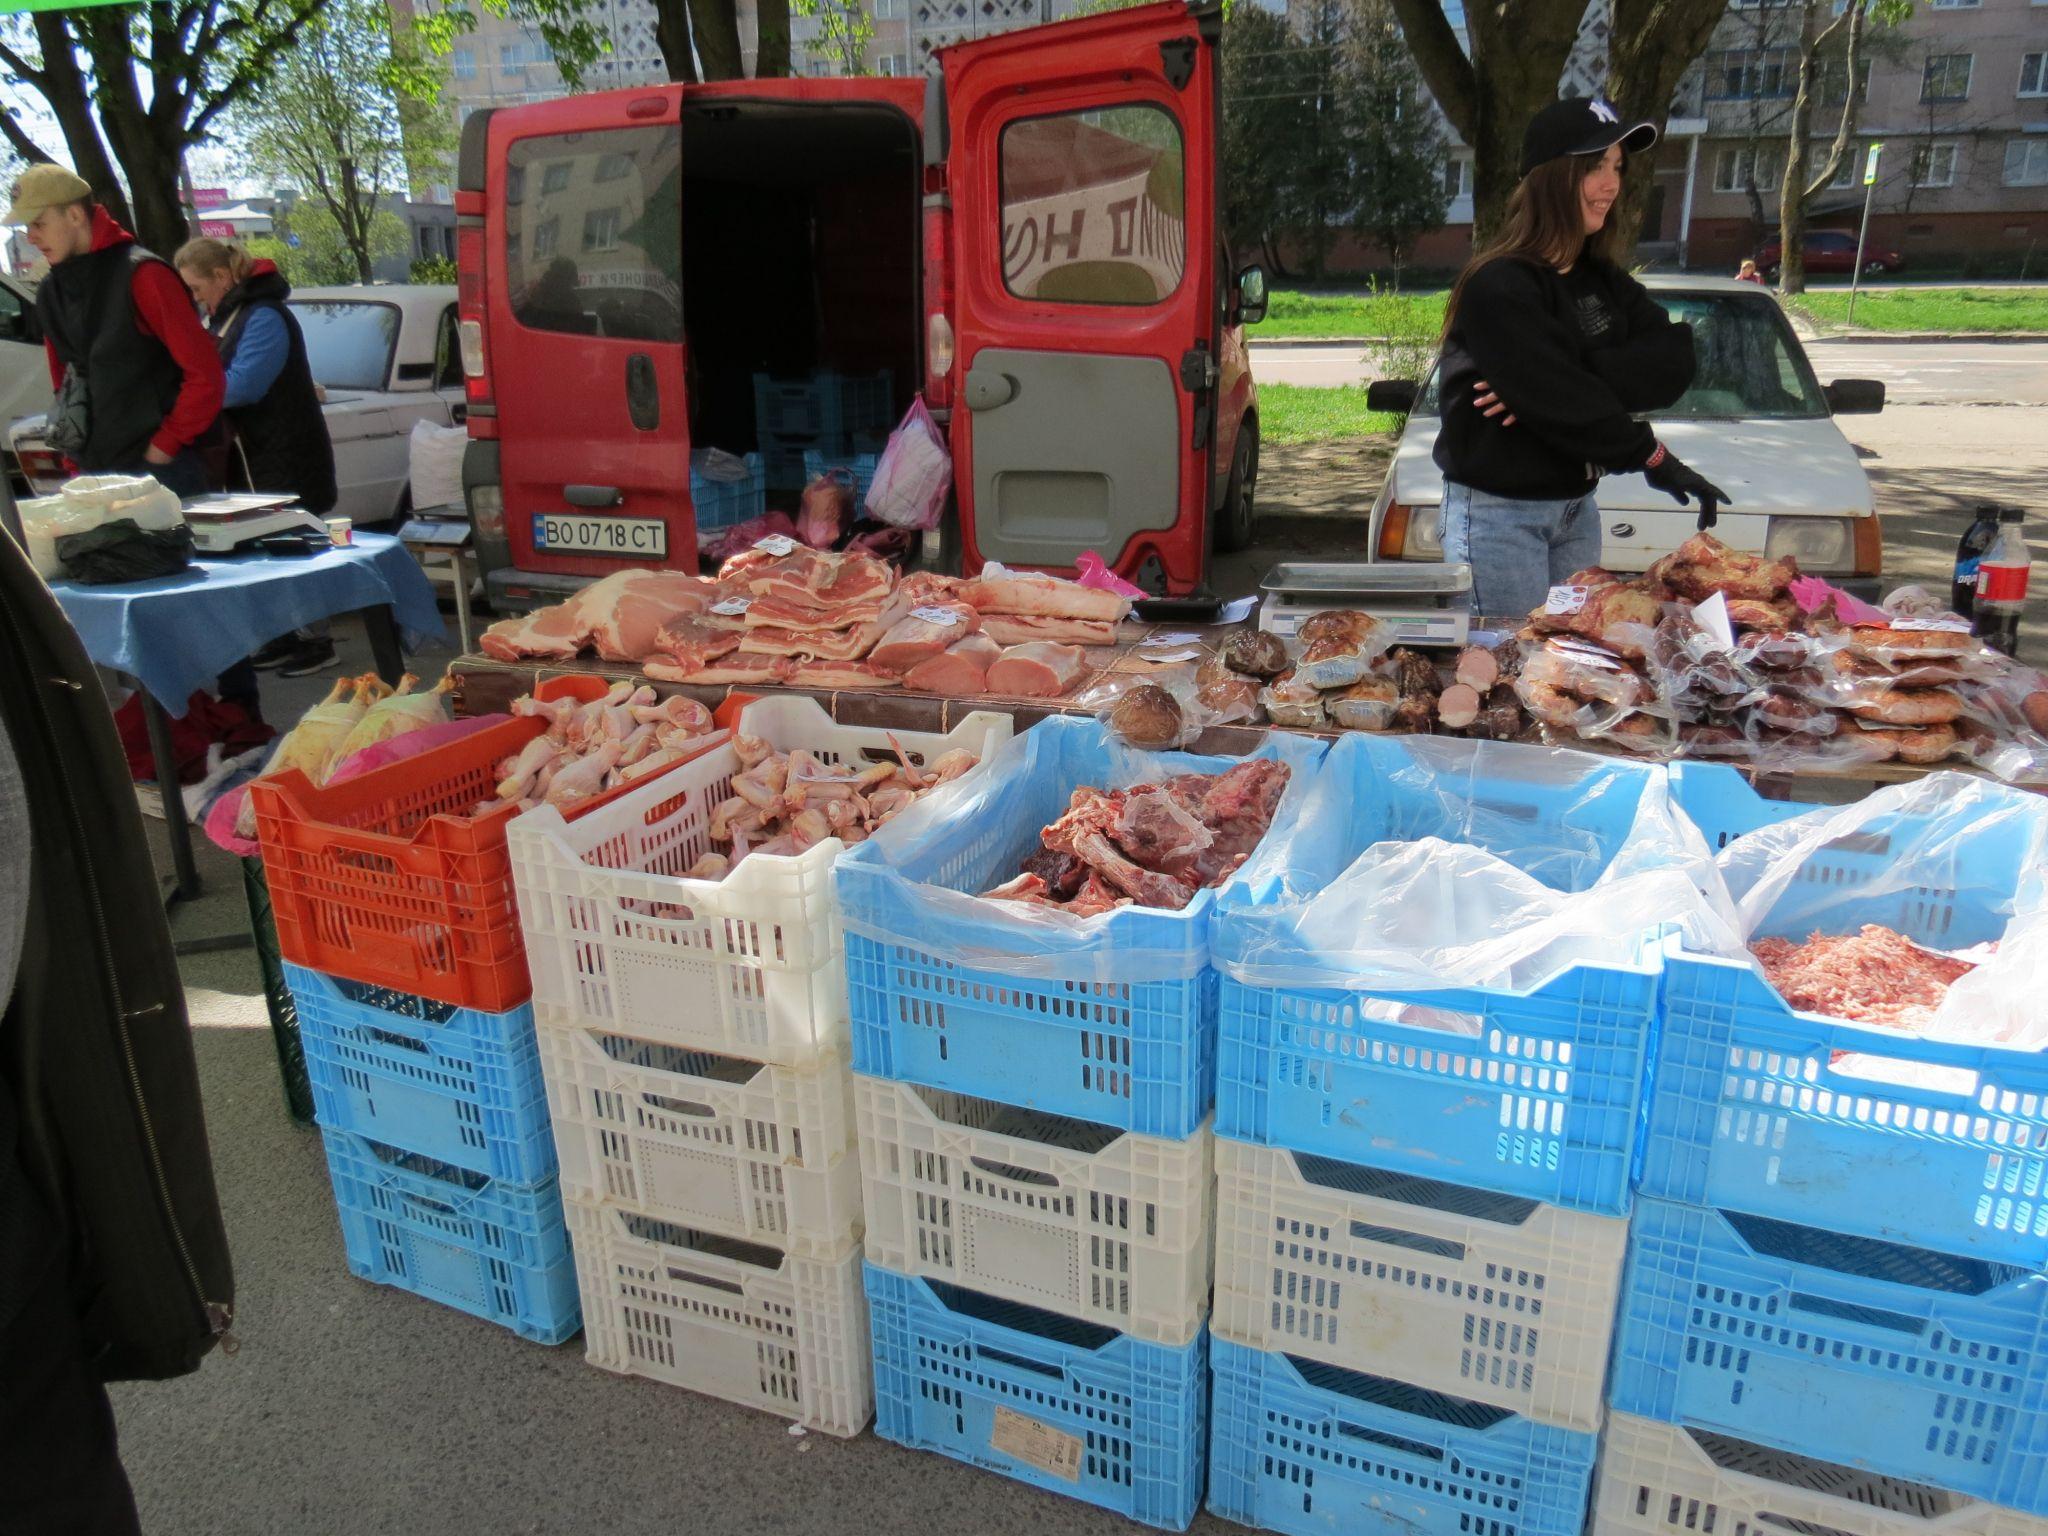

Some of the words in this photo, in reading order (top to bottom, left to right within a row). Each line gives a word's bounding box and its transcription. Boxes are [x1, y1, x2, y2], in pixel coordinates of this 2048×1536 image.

[546, 521, 573, 544] BO
[579, 523, 626, 547] 0718
[632, 525, 661, 549] CT
